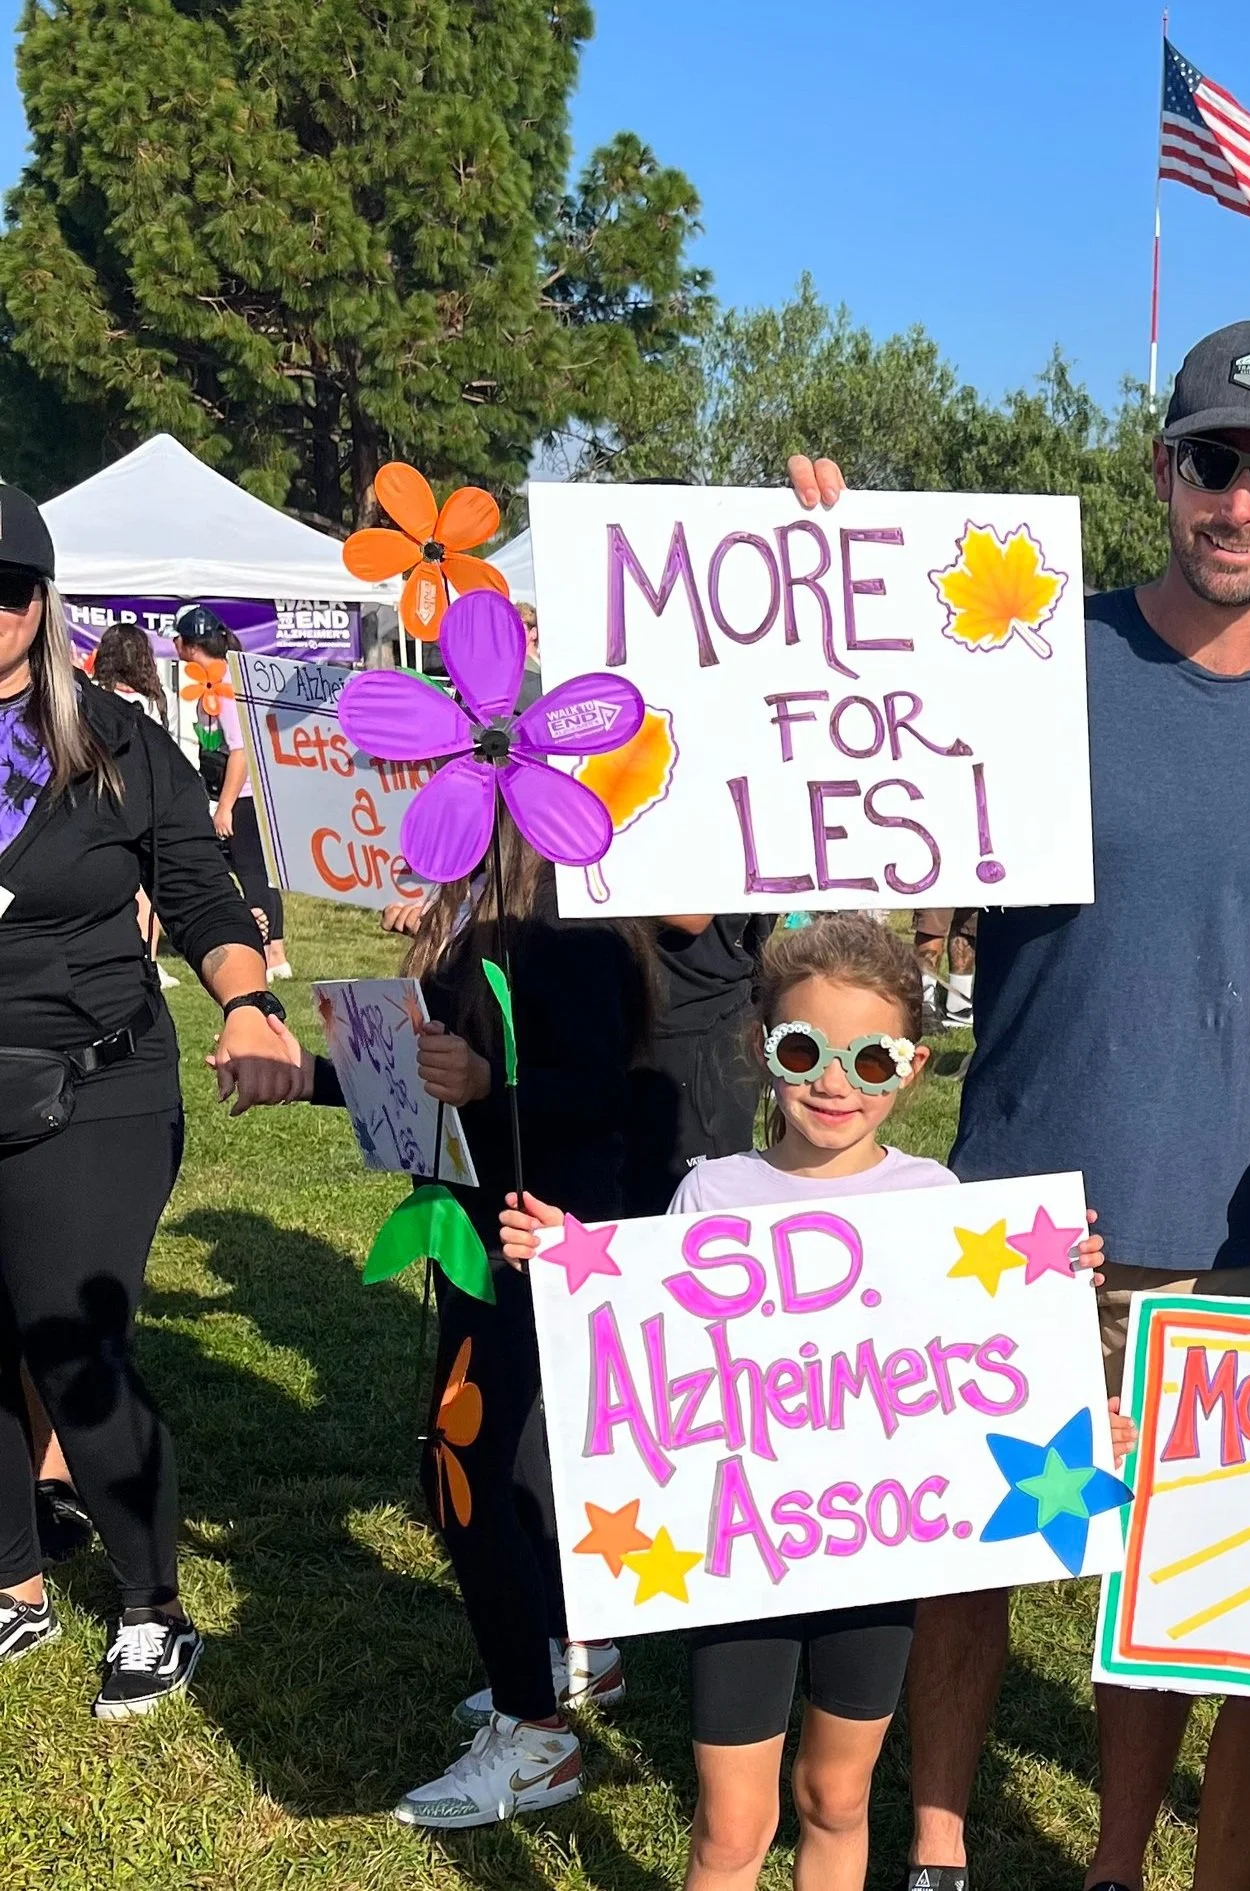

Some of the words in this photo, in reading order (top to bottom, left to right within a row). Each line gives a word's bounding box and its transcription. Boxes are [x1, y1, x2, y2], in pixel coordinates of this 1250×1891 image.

[71, 605, 138, 628] HELP
[142, 611, 176, 632] TE
[295, 610, 350, 630] END
[606, 519, 915, 681] MORE
[546, 703, 578, 721] WALK
[579, 700, 595, 714] TO
[550, 712, 598, 732] END
[764, 691, 974, 762] FOR
[265, 714, 355, 777] Let's
[351, 788, 386, 836] a
[310, 828, 424, 899] Cure
[662, 1211, 881, 1320] S.D.
[582, 1301, 1029, 1487] Alzheimers
